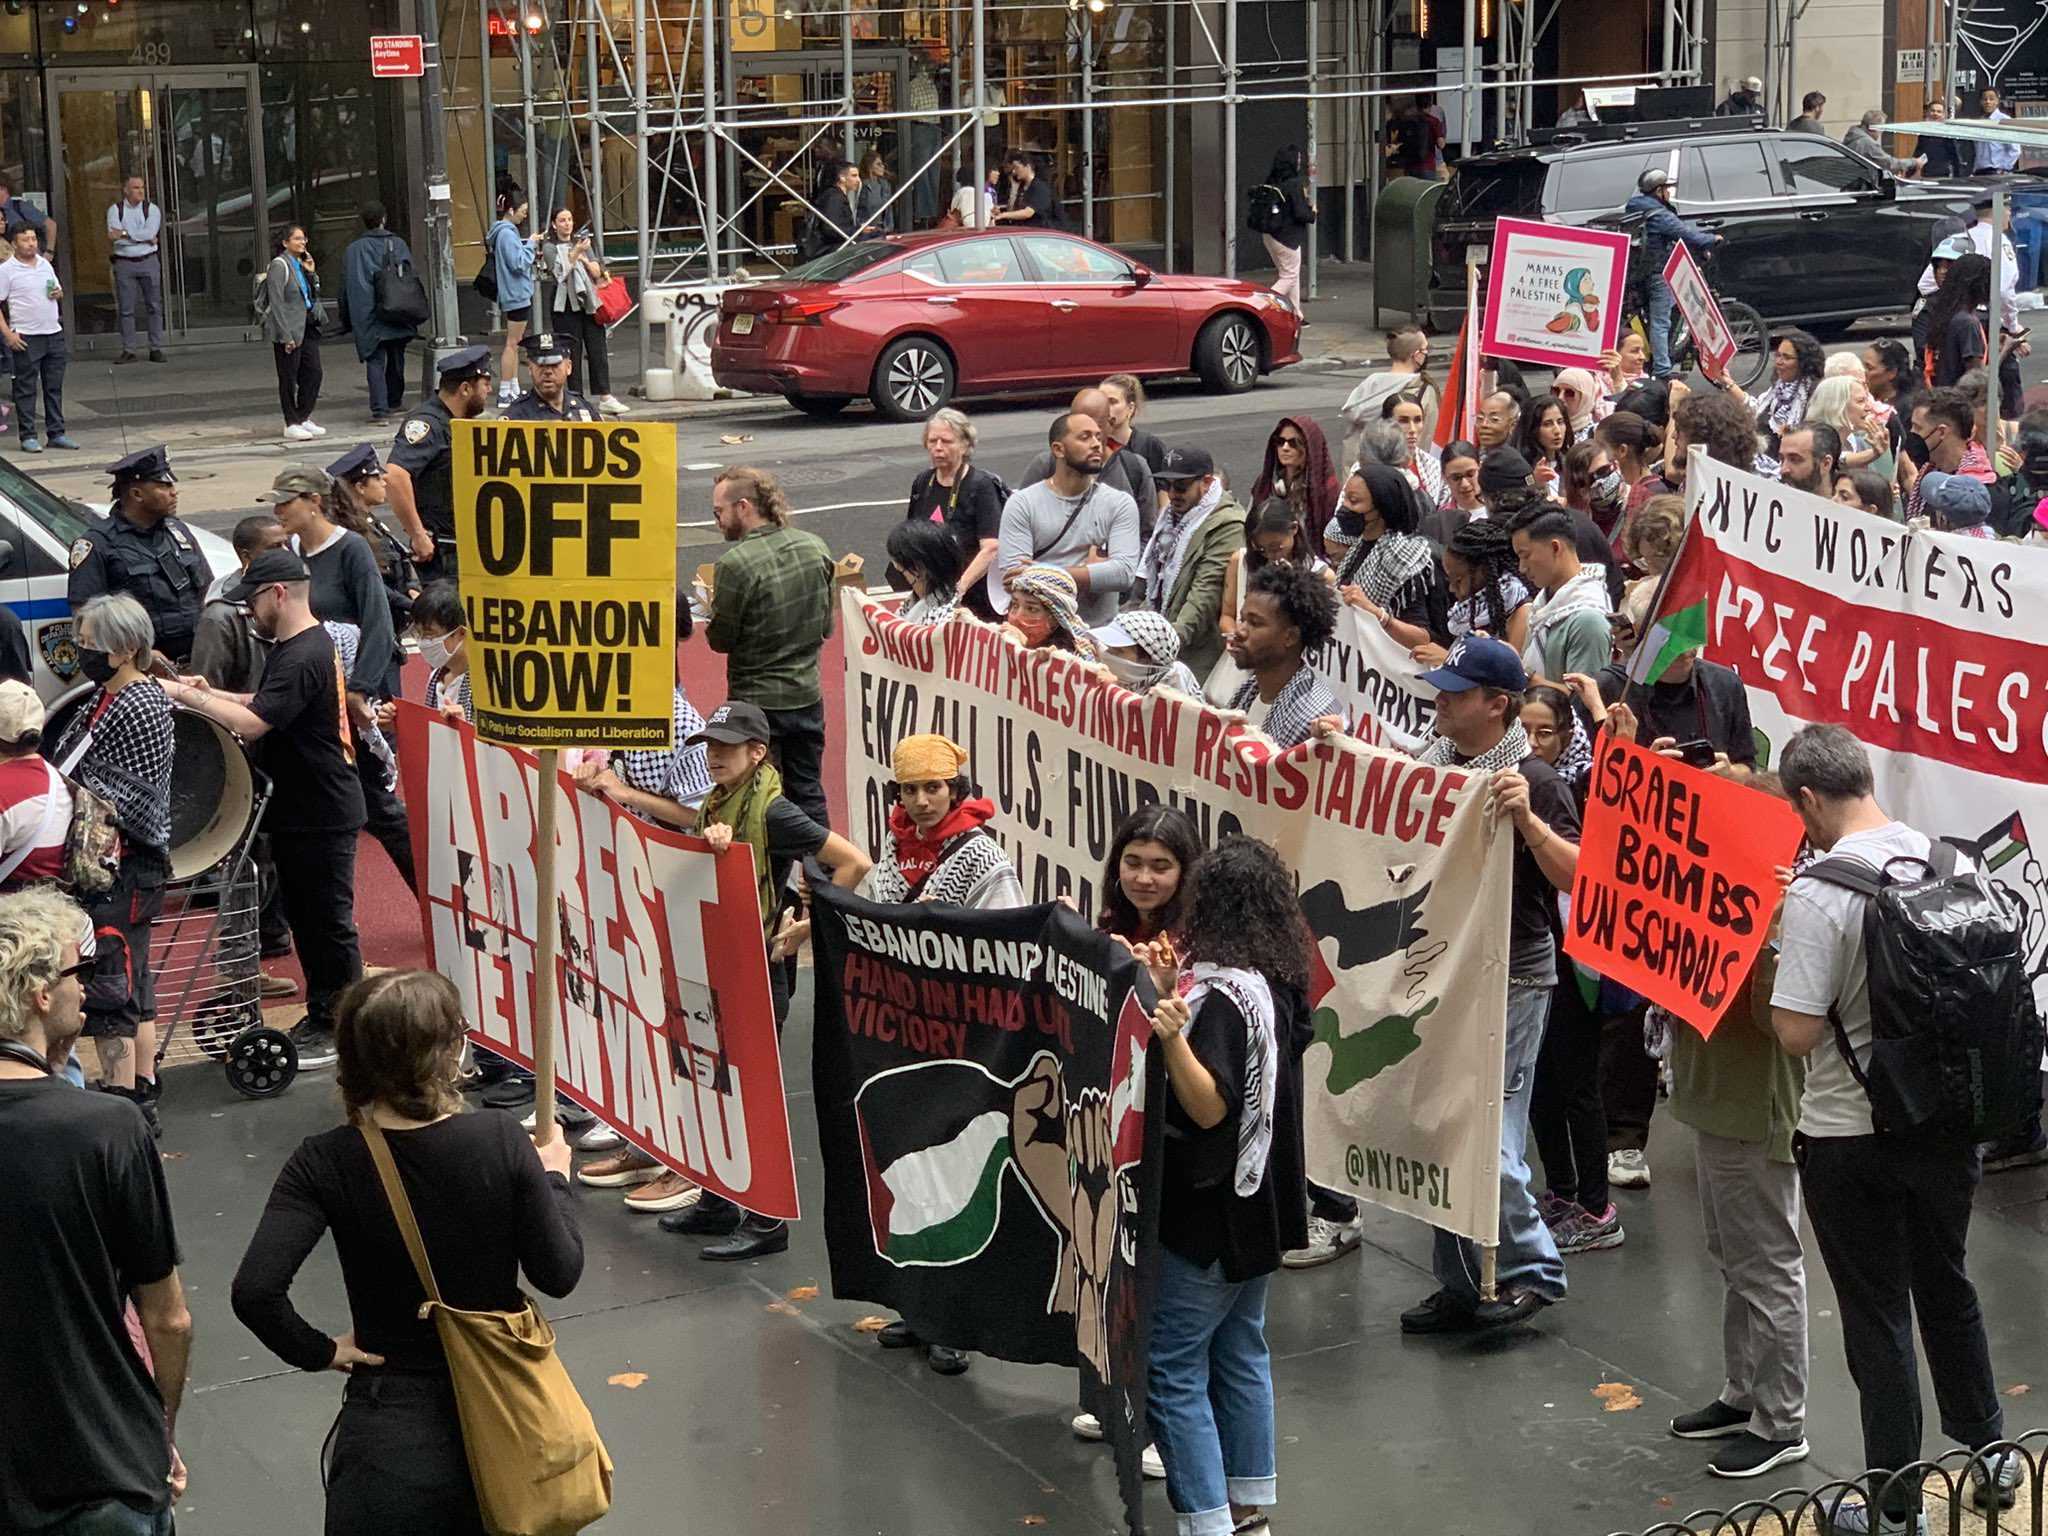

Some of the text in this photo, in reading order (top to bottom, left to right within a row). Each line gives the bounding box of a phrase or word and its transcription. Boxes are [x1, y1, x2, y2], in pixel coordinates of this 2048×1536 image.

[131, 42, 171, 65] 489
[374, 40, 414, 49] NO STANDING
[374, 50, 401, 59] Anytime
[1510, 287, 1561, 303] PALESTINE
[1519, 275, 1561, 290] 4 A FREE
[1526, 263, 1564, 277] MAMAS
[472, 426, 642, 479] HANDS
[475, 480, 642, 577] OFF
[1708, 476, 2014, 619] NYC WORKERS
[466, 596, 661, 647] LEBANON
[483, 648, 632, 713] NOW!
[1841, 630, 2048, 756] PALES
[488, 720, 665, 739] Party for Socialism and Liberation
[861, 603, 937, 673] STAND
[943, 620, 1003, 696] WITH
[1005, 641, 1182, 767] PALESTINIAN
[1193, 708, 1468, 848] RESISTANCE
[997, 715, 1052, 838] U.S.
[1595, 738, 1709, 857] ISRAEL
[427, 720, 720, 1028] ARREST
[1615, 825, 1760, 936] BOMBS
[835, 910, 972, 974] LEBANON
[1577, 875, 1740, 1011] UN SCHOOLS
[844, 952, 916, 1010] HAND
[922, 978, 957, 1018] IN
[844, 993, 968, 1058] VICTORY
[1345, 1143, 1452, 1210] @NYCPSL
